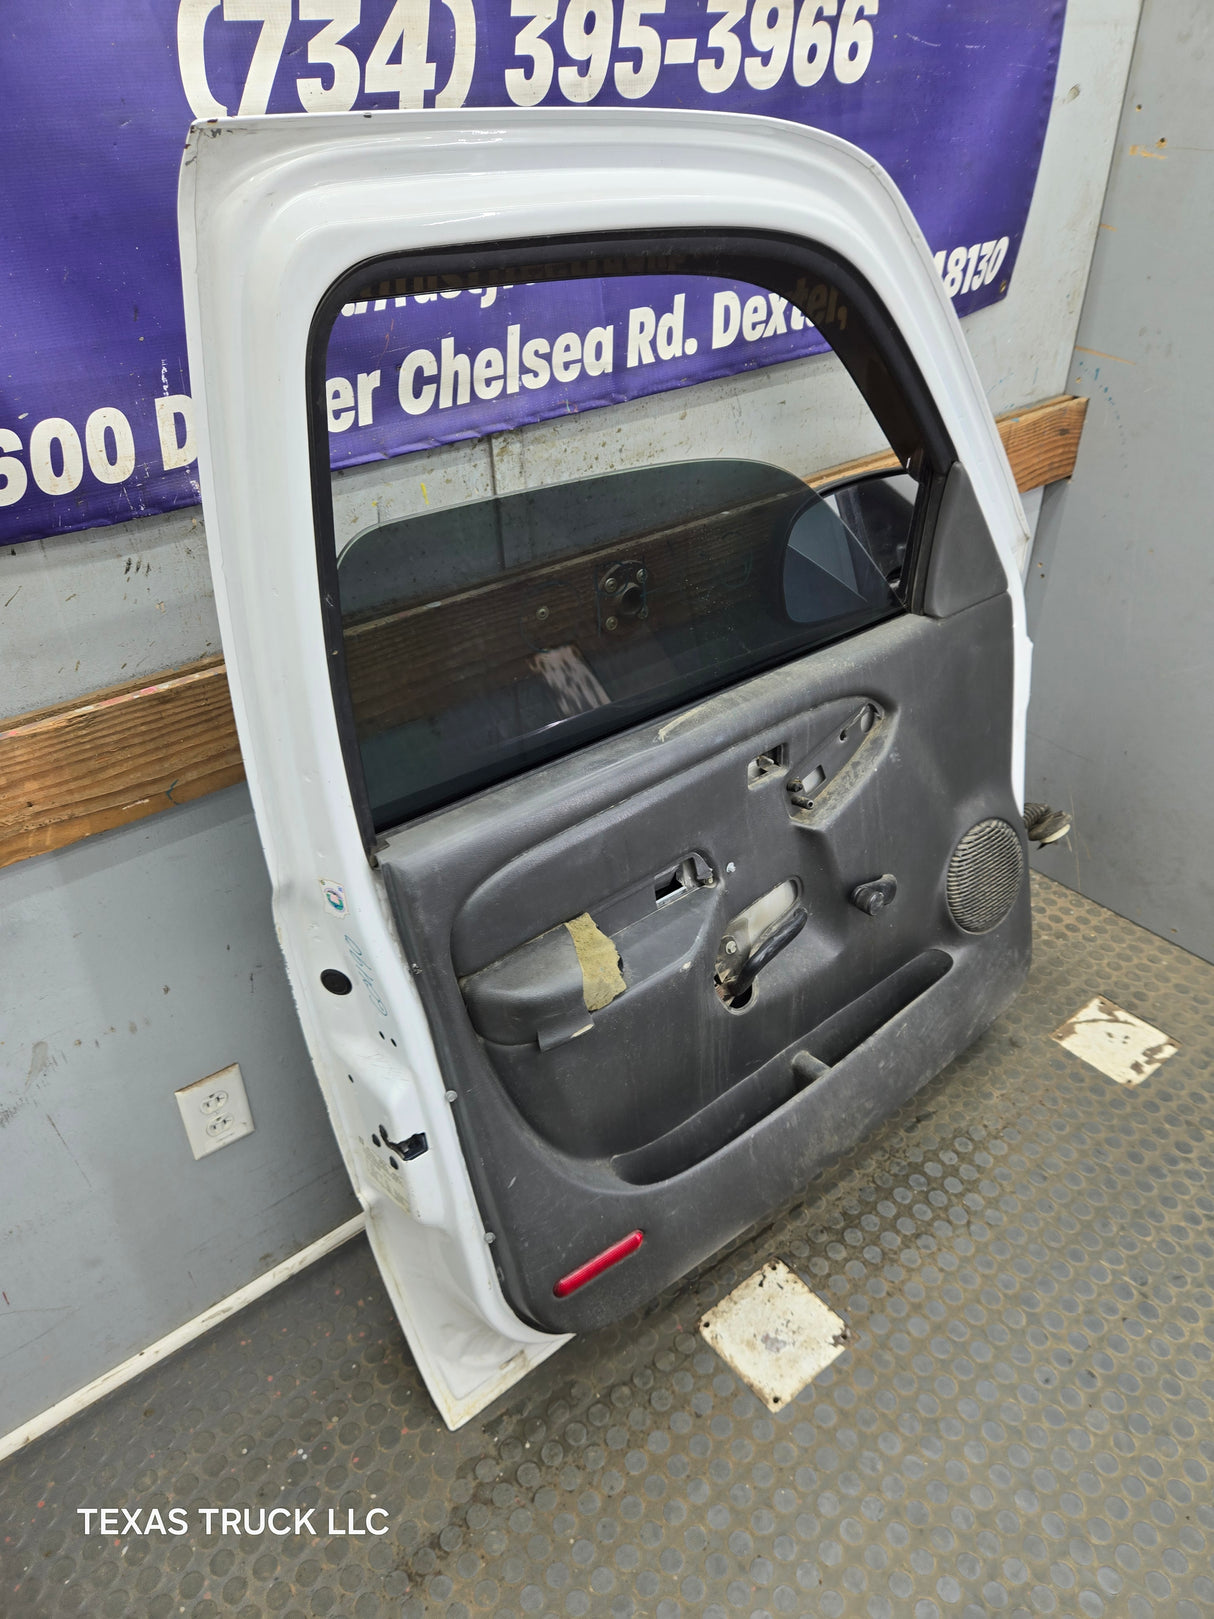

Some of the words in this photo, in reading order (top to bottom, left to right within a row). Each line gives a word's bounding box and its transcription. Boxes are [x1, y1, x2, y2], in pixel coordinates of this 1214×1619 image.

[177, 0, 476, 118] (734)
[505, 0, 879, 107] 395-3966
[398, 323, 614, 416] Chelsea
[626, 293, 698, 368] Rd.
